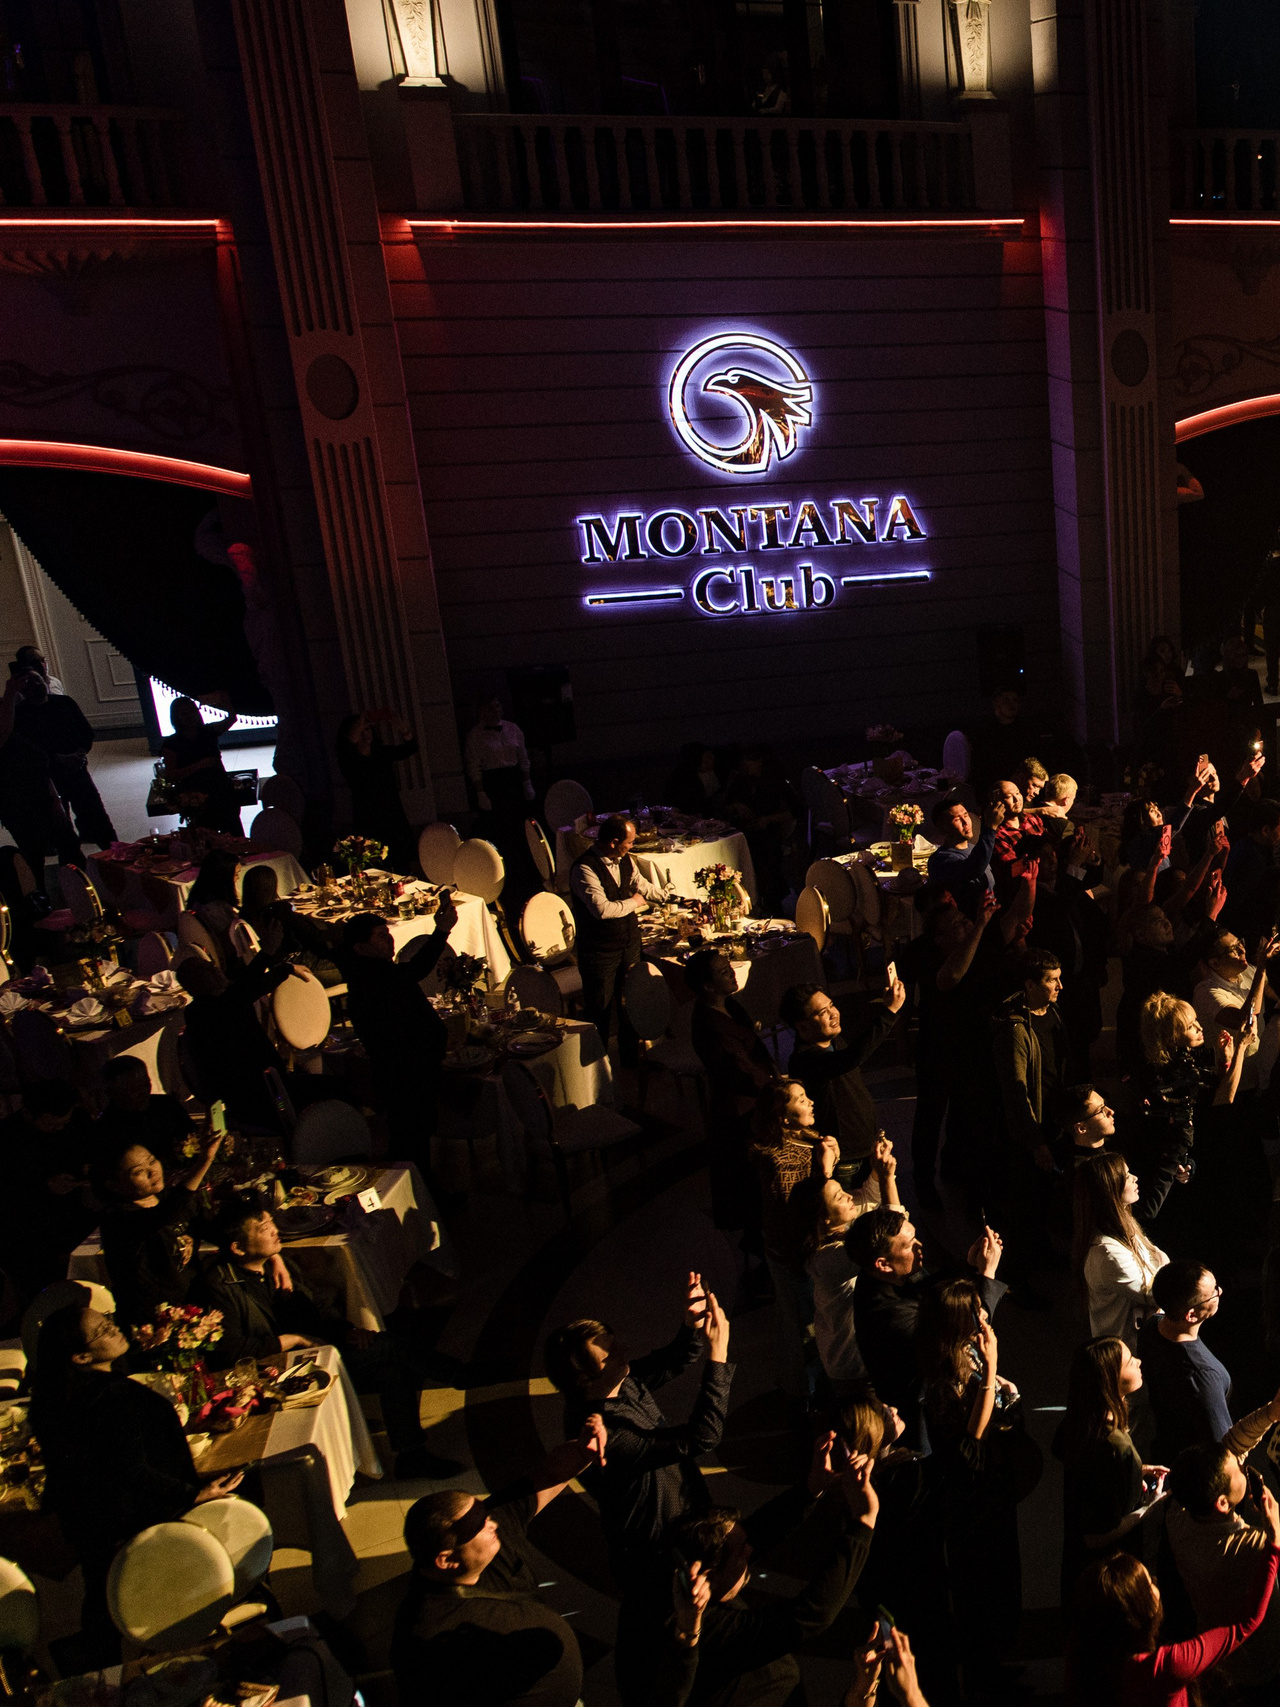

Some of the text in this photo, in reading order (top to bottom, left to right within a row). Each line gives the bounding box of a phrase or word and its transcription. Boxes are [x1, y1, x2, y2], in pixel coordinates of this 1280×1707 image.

[577, 495, 928, 564] MONTANA
[692, 563, 837, 616] Club
[367, 1196, 375, 1208] 4
